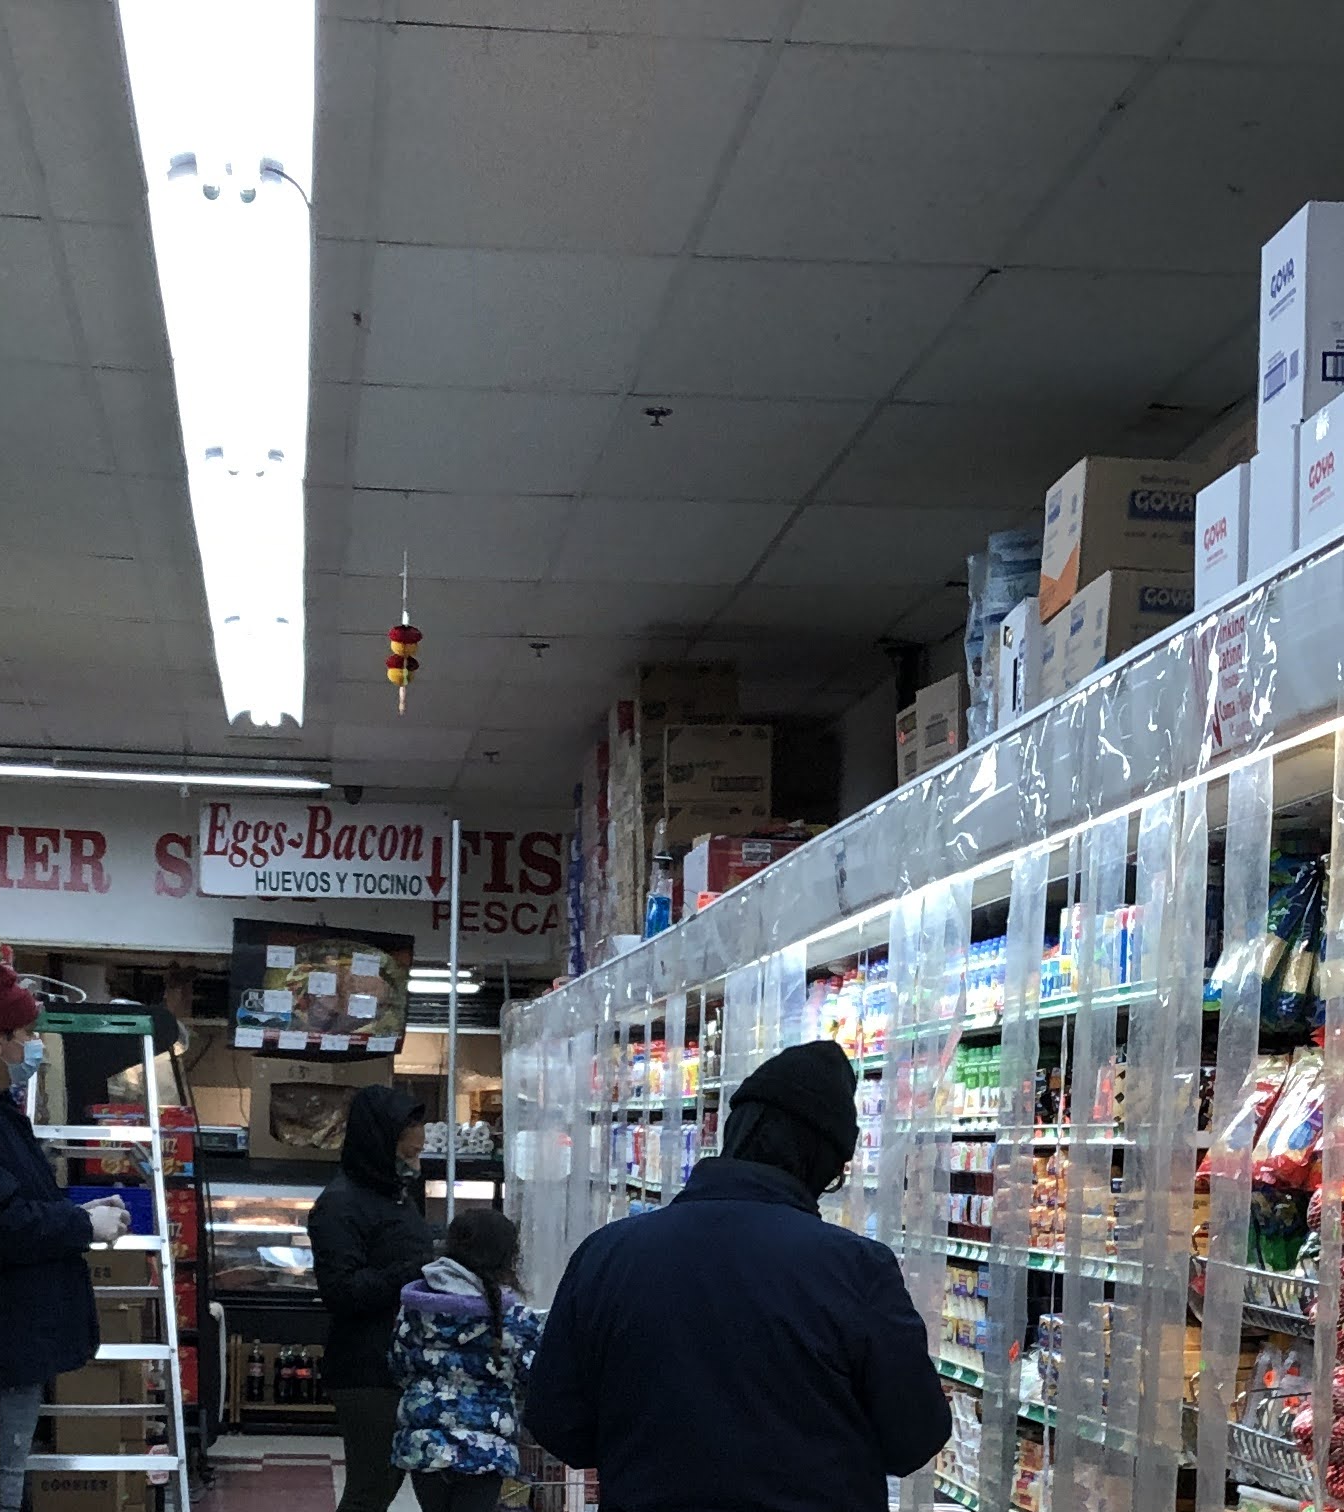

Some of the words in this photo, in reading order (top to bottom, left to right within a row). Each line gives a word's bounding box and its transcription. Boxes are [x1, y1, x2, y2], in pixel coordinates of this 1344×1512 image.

[1270, 257, 1295, 299] GOYA
[1204, 516, 1228, 551] GOYA
[255, 870, 332, 893] HUEVOS
[336, 873, 349, 894] Y
[354, 872, 423, 897] TOCINO
